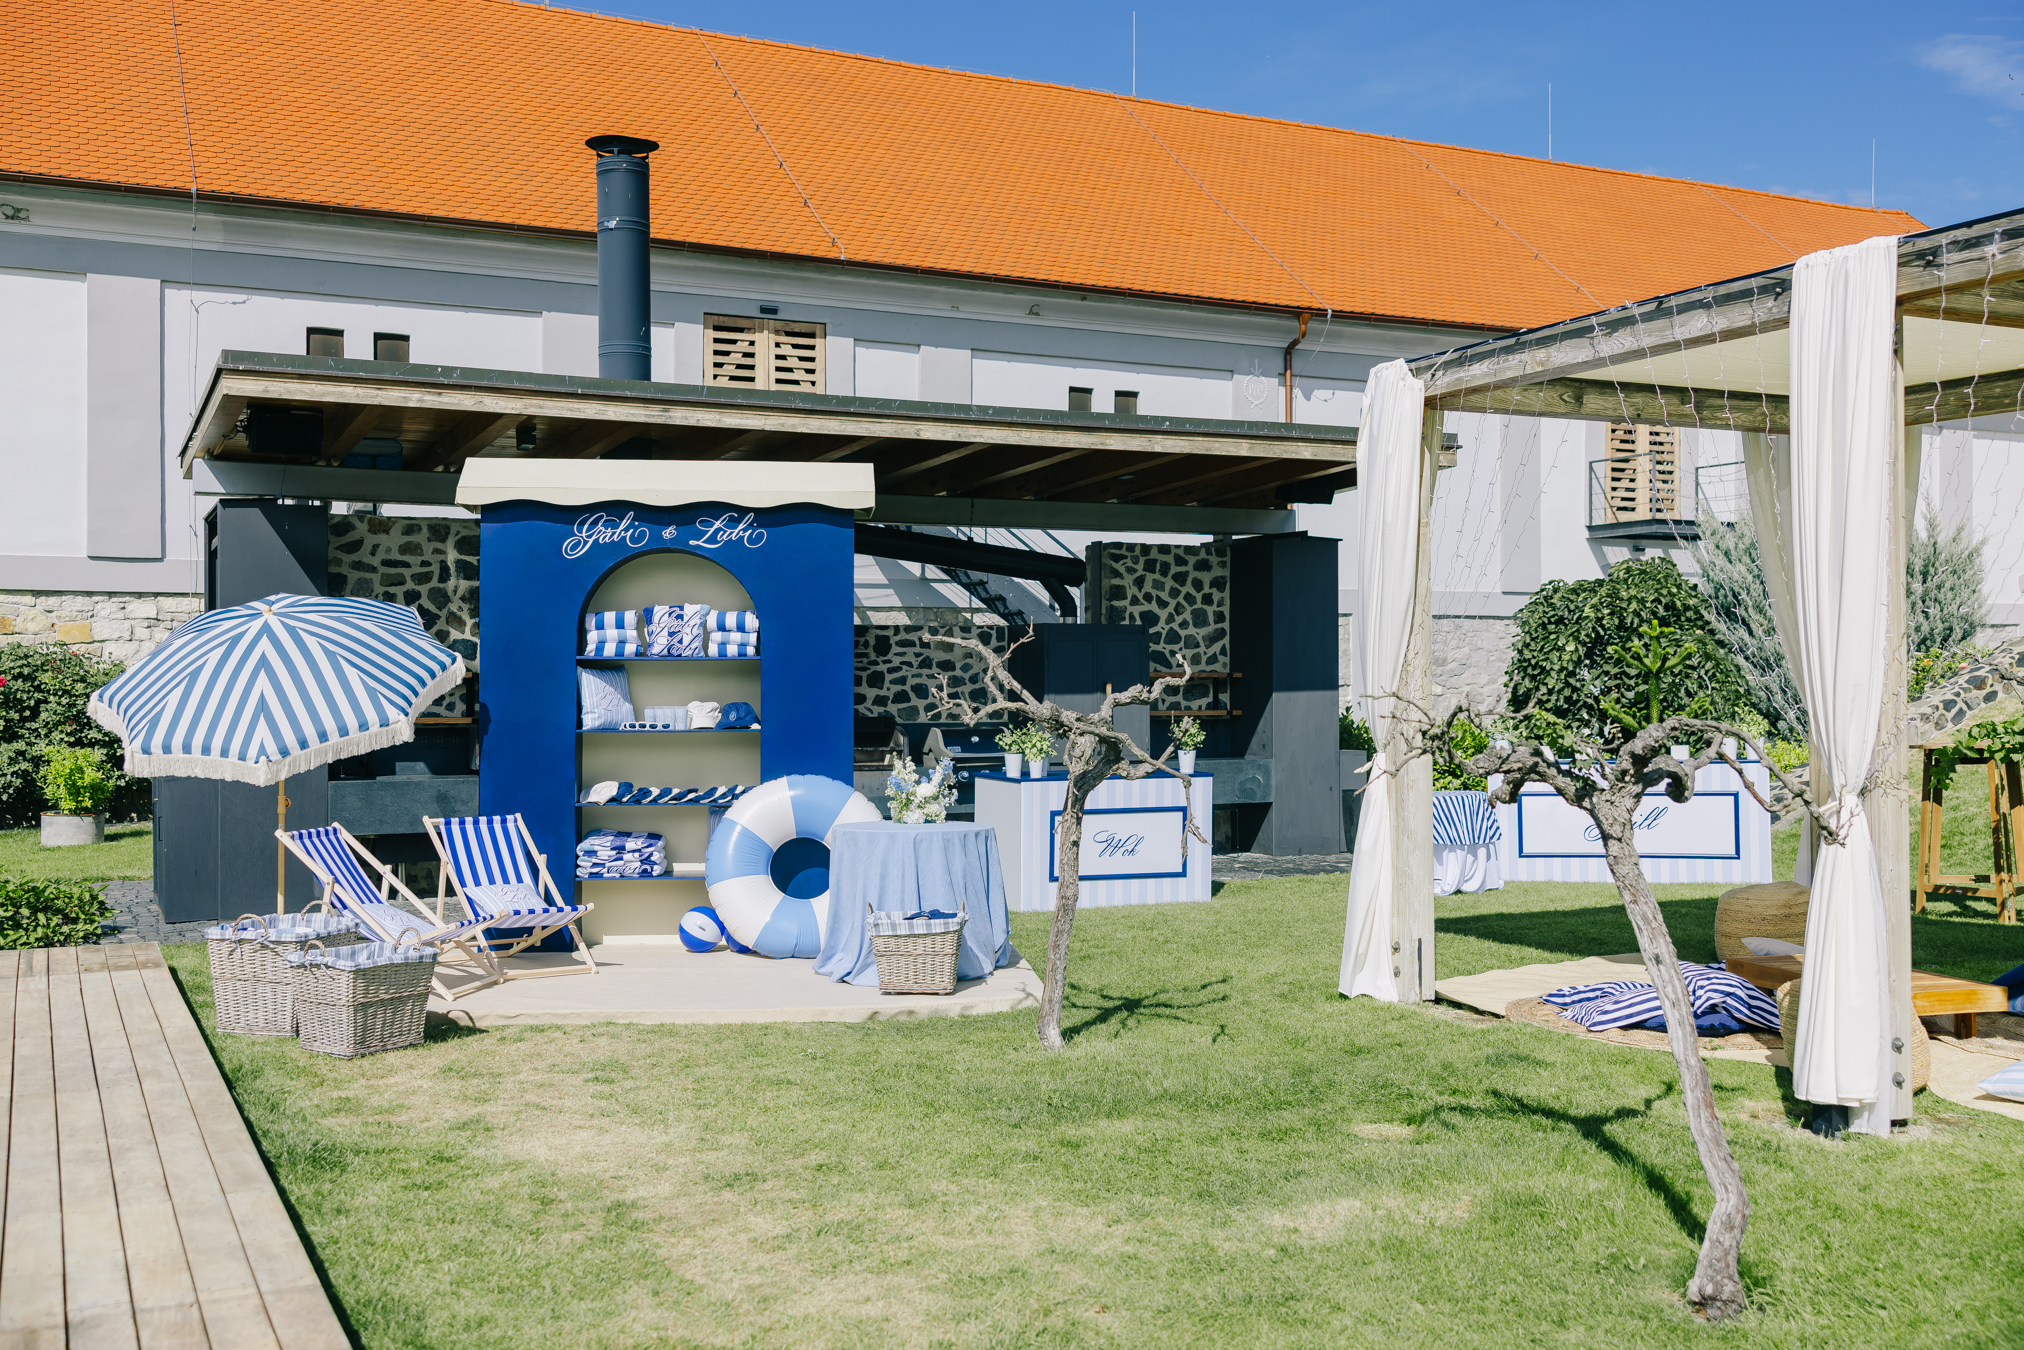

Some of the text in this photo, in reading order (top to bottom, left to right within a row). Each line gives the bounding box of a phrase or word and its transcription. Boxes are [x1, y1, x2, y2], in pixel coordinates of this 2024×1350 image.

[662, 525, 677, 540] &
[1583, 806, 1669, 842] ill
[1093, 830, 1145, 858] Wok
